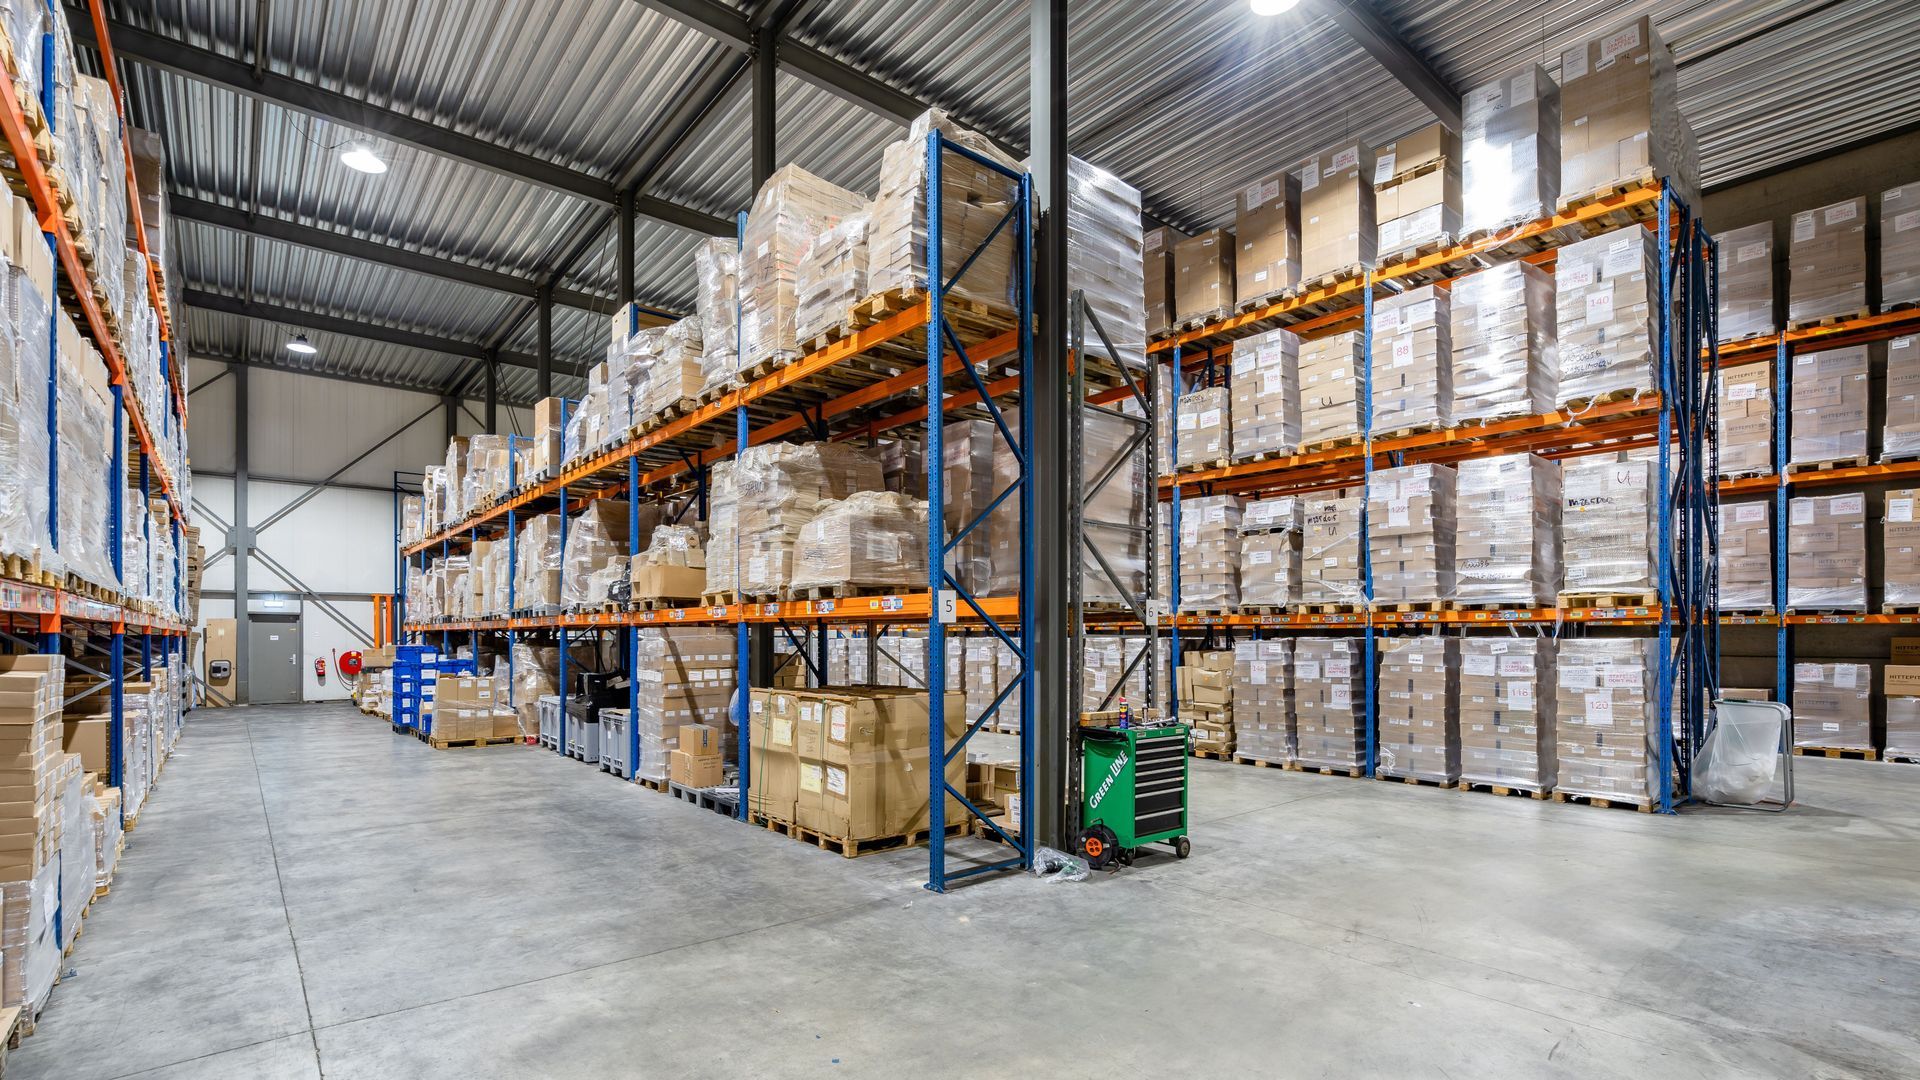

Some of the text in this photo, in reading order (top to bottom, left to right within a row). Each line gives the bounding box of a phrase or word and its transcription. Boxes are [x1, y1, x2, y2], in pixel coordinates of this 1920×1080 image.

[1591, 296, 1609, 307] 140
[1397, 346, 1408, 356] 88
[1728, 371, 1753, 380] HITTEPIT
[945, 599, 953, 613] 5
[1148, 607, 1154, 618] 6
[1591, 701, 1609, 709] 120
[1089, 750, 1129, 809] GREEN LINE
